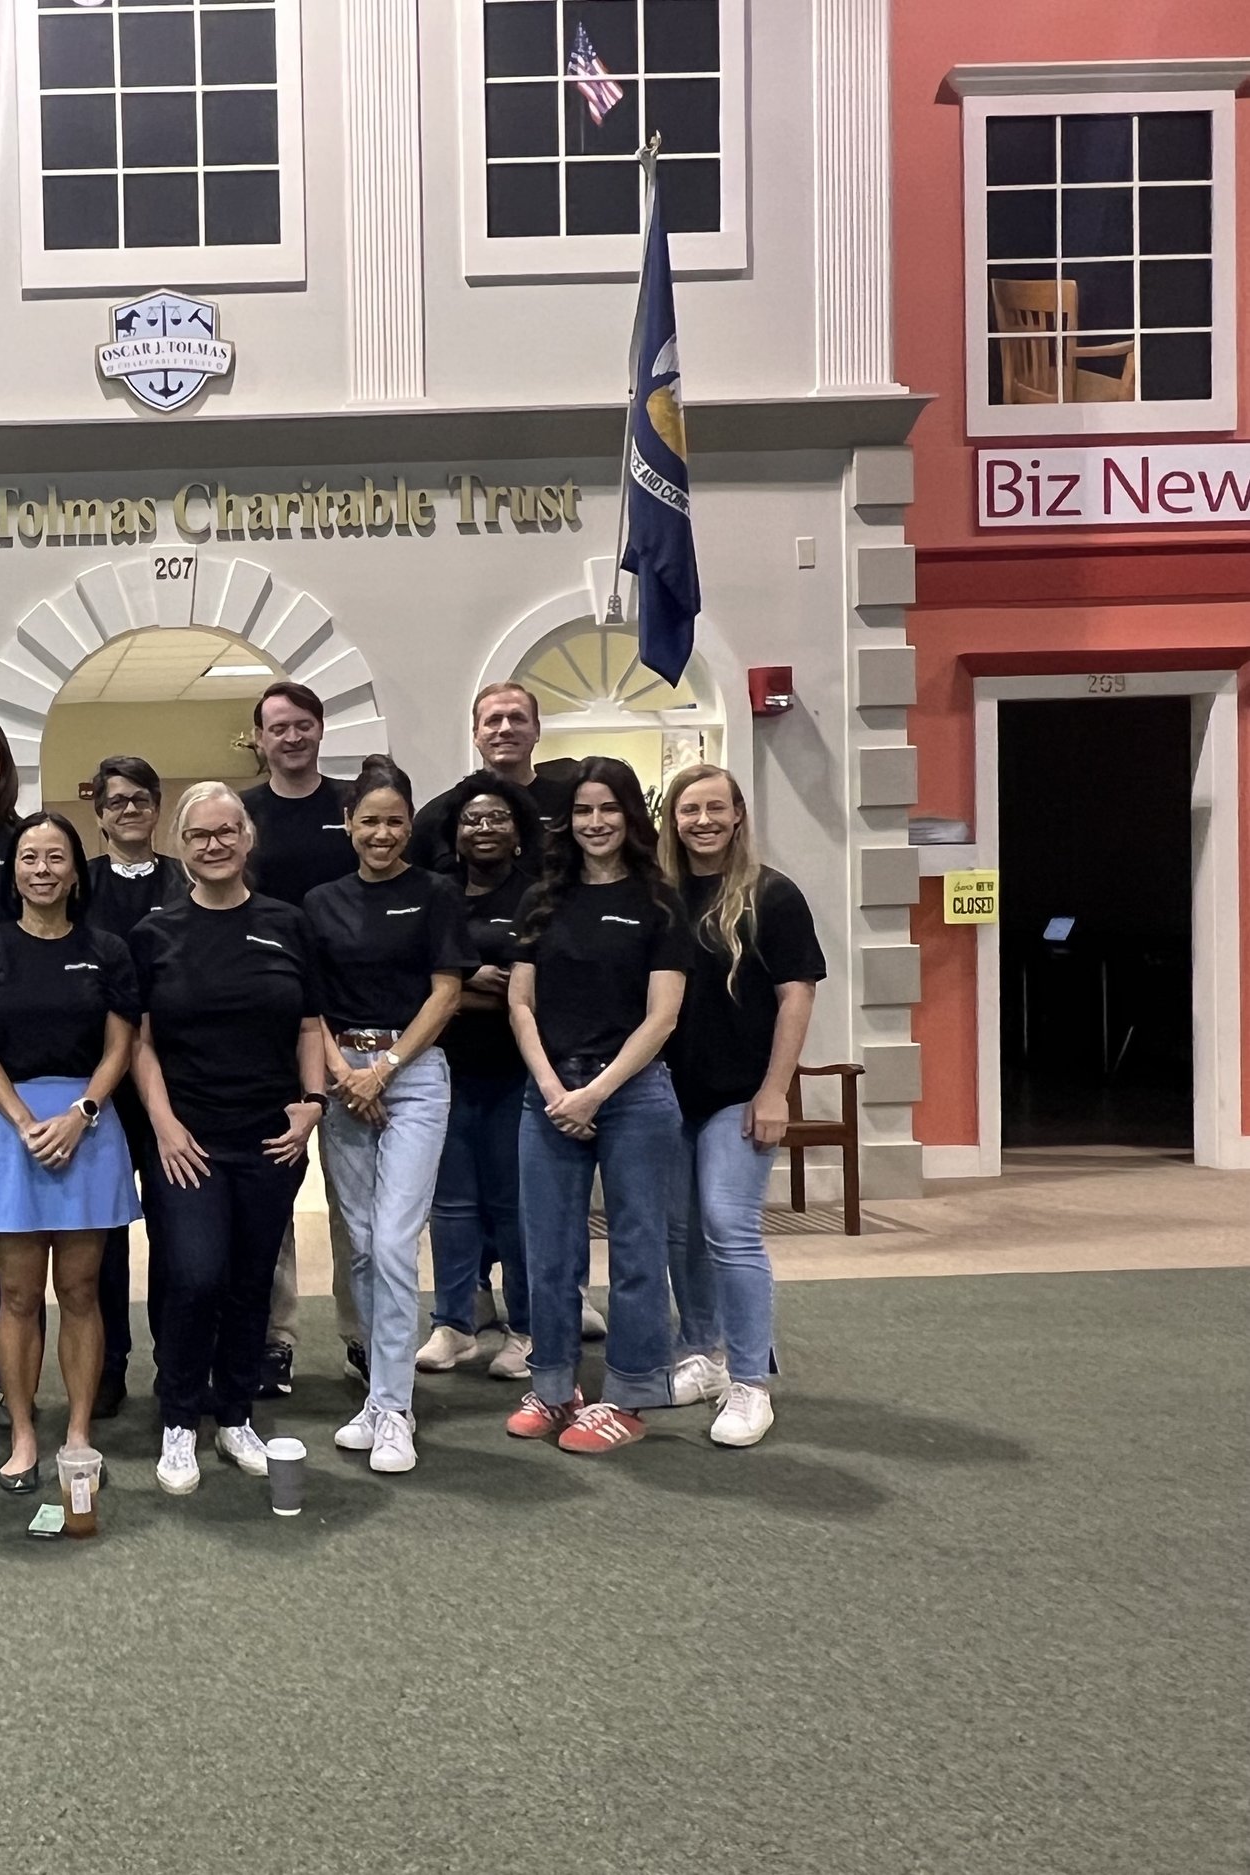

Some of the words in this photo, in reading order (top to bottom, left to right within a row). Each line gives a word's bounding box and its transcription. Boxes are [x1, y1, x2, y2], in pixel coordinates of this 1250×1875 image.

[102, 342, 151, 361] OSCAR
[155, 341, 165, 355] J.
[167, 341, 228, 359] TOLMAS
[638, 469, 663, 491] AND
[986, 459, 1082, 518] Biz
[1103, 456, 1250, 515] New
[174, 475, 435, 535] Charitable
[449, 473, 582, 525] Trust
[155, 556, 194, 580] 207
[953, 896, 994, 915] CLOSED
